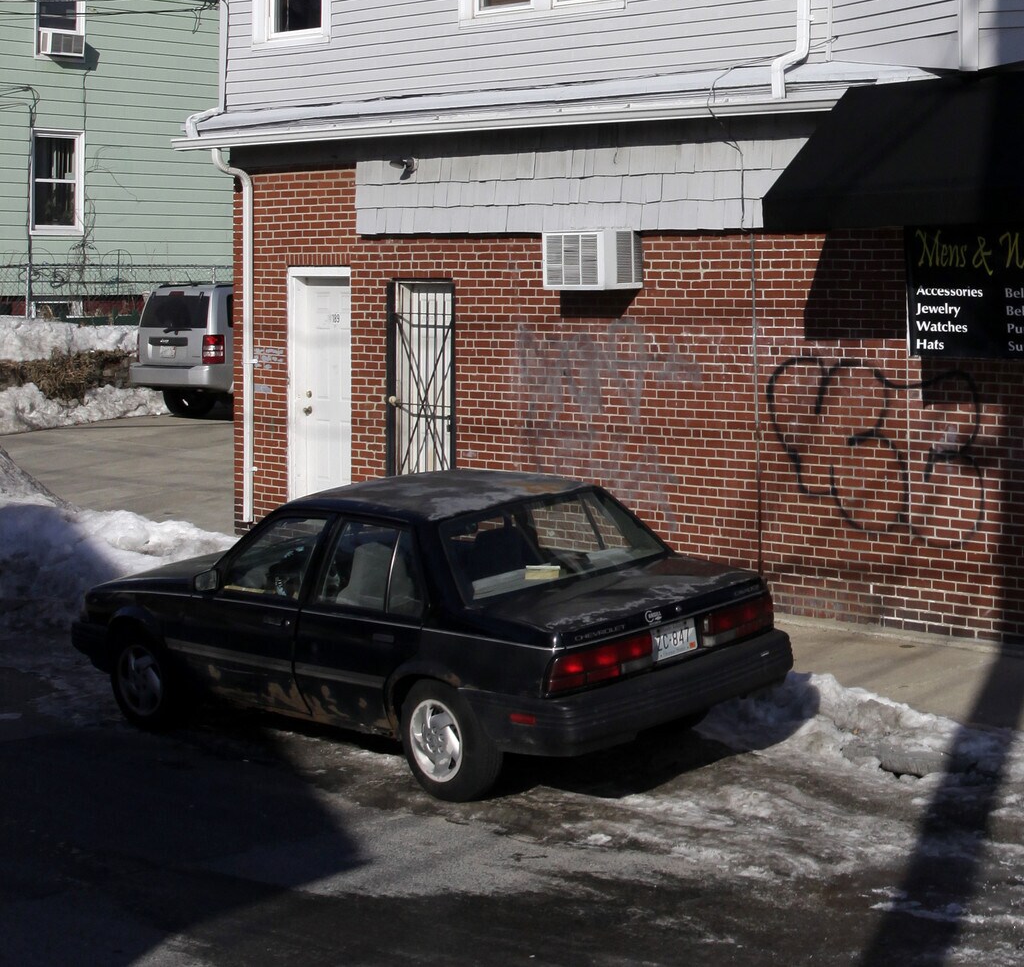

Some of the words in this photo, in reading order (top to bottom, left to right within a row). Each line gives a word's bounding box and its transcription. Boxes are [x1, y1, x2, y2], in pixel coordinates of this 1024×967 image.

[916, 230, 967, 267] Mens
[972, 236, 993, 276] &
[916, 286, 983, 298] Accessories
[916, 303, 961, 318] Jewelry
[916, 320, 968, 333] Watches
[916, 338, 944, 350] Hats
